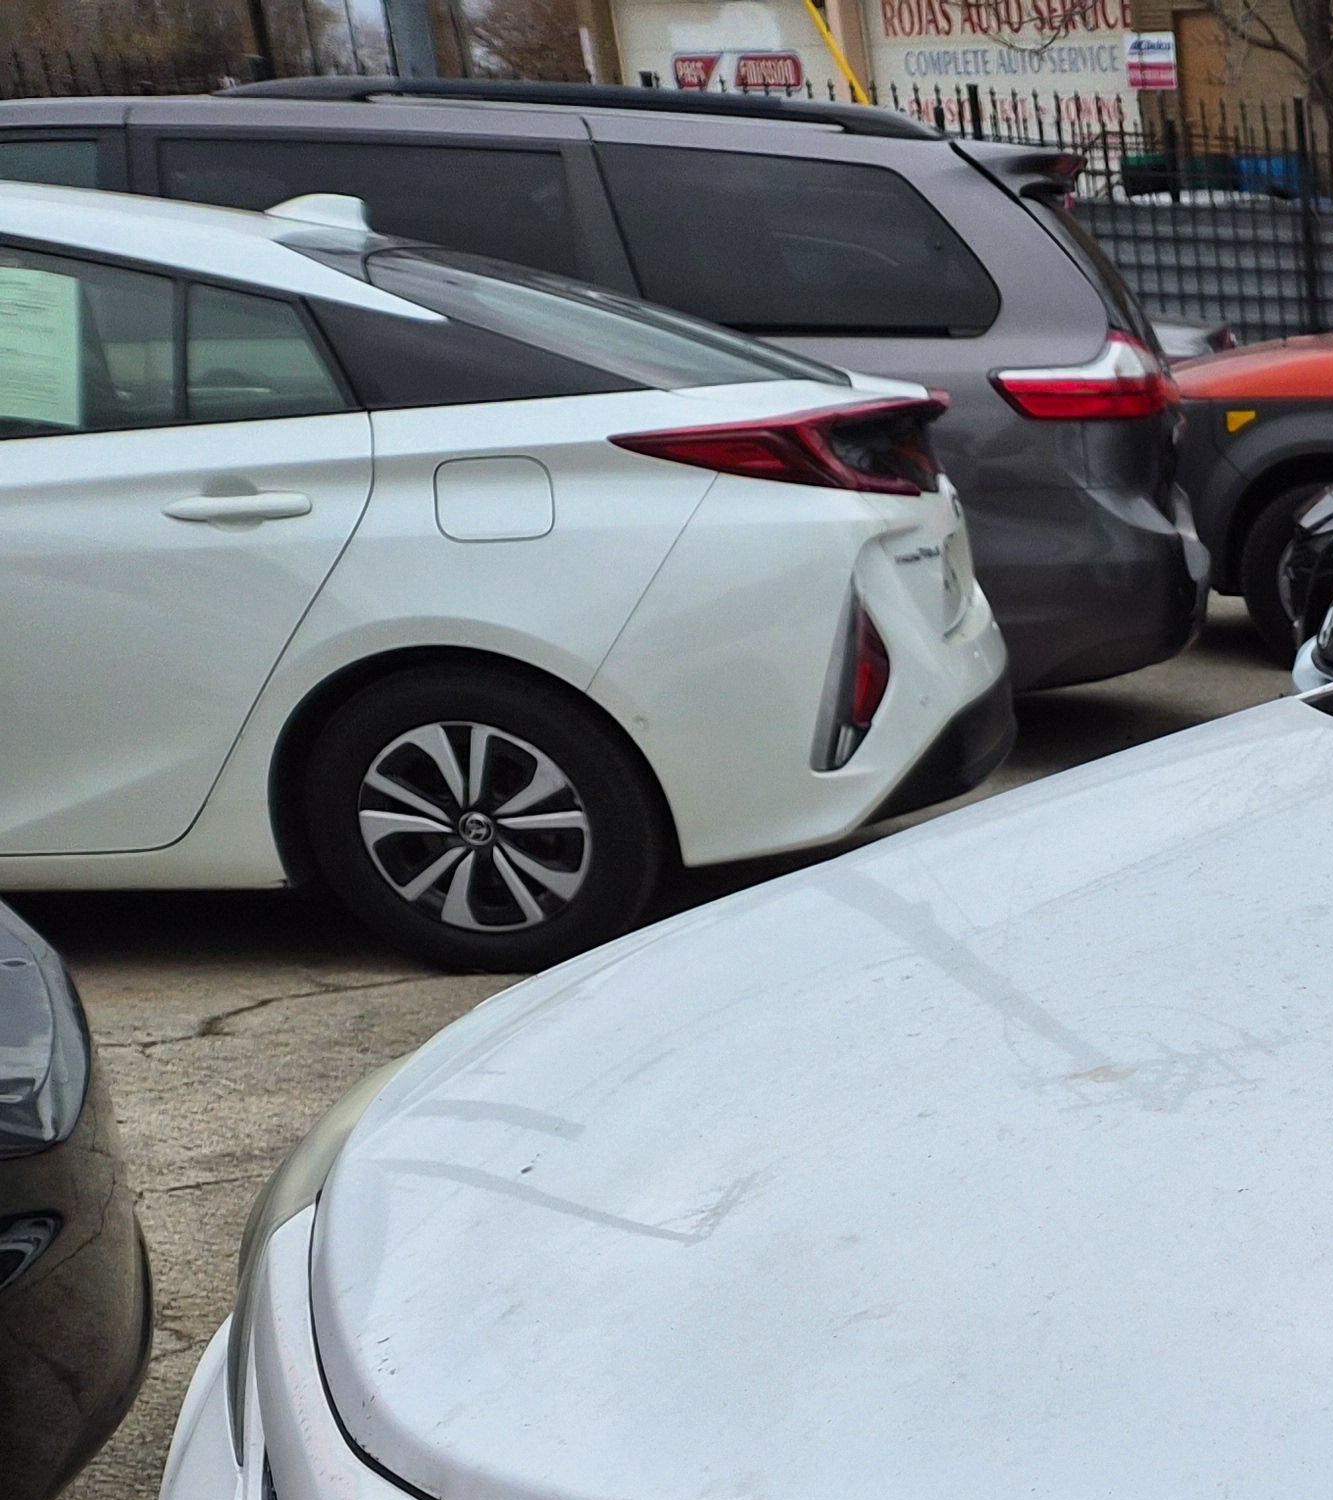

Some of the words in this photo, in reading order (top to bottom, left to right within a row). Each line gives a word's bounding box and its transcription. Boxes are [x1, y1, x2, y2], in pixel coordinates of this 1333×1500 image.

[882, 0, 951, 36] ROJAS
[961, 0, 1023, 33] AUTO
[904, 50, 991, 76] COMPLETE
[996, 47, 1042, 74] AUTO
[1051, 45, 1121, 73] SERVICE
